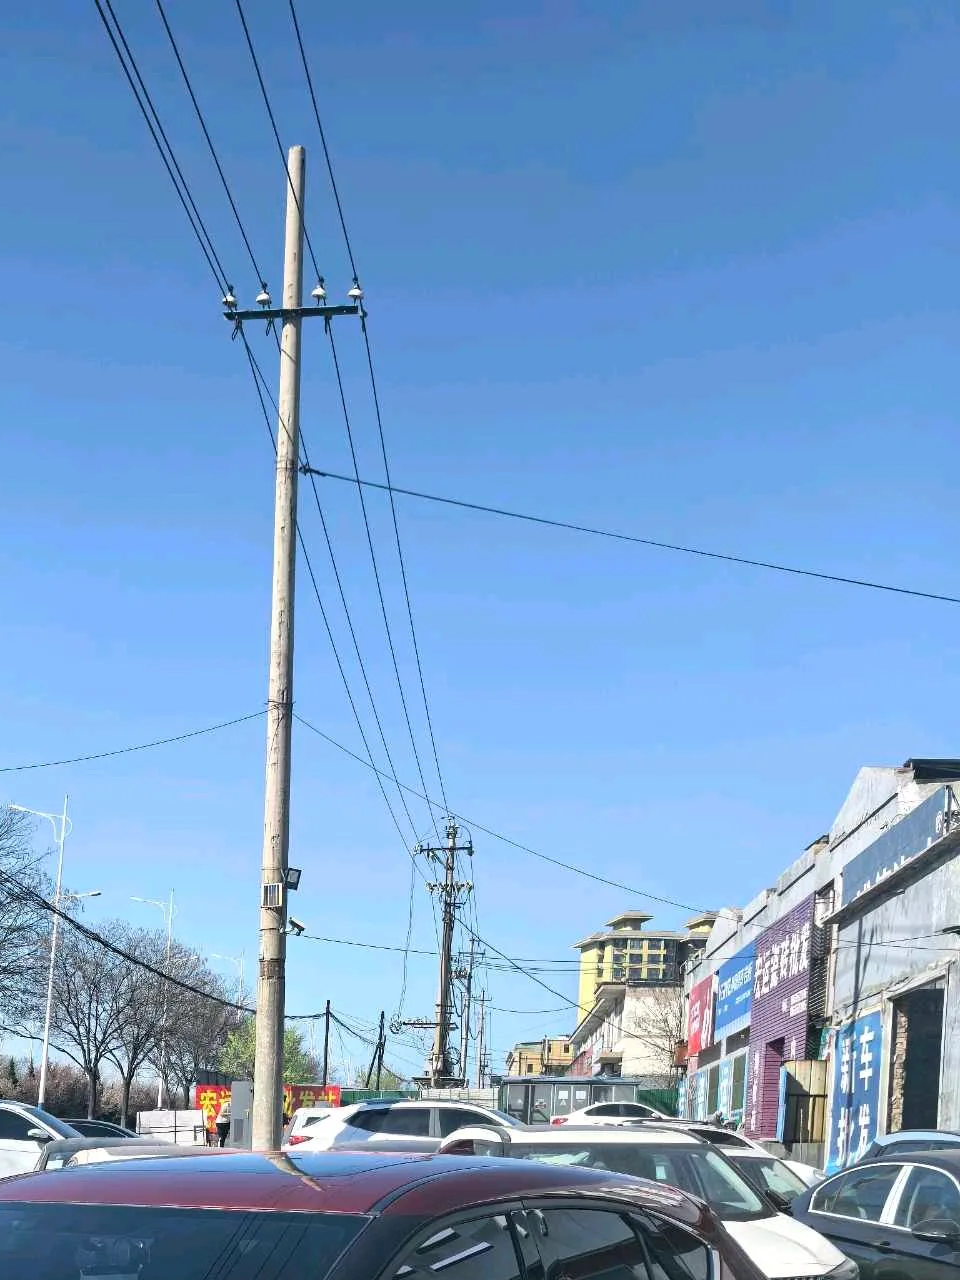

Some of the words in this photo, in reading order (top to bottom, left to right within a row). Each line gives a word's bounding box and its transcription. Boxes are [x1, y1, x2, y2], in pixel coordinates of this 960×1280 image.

[754, 921, 809, 1000] 宏运瓷砖批发
[841, 1026, 875, 1095] 新车
[837, 1103, 871, 1166] 批发
